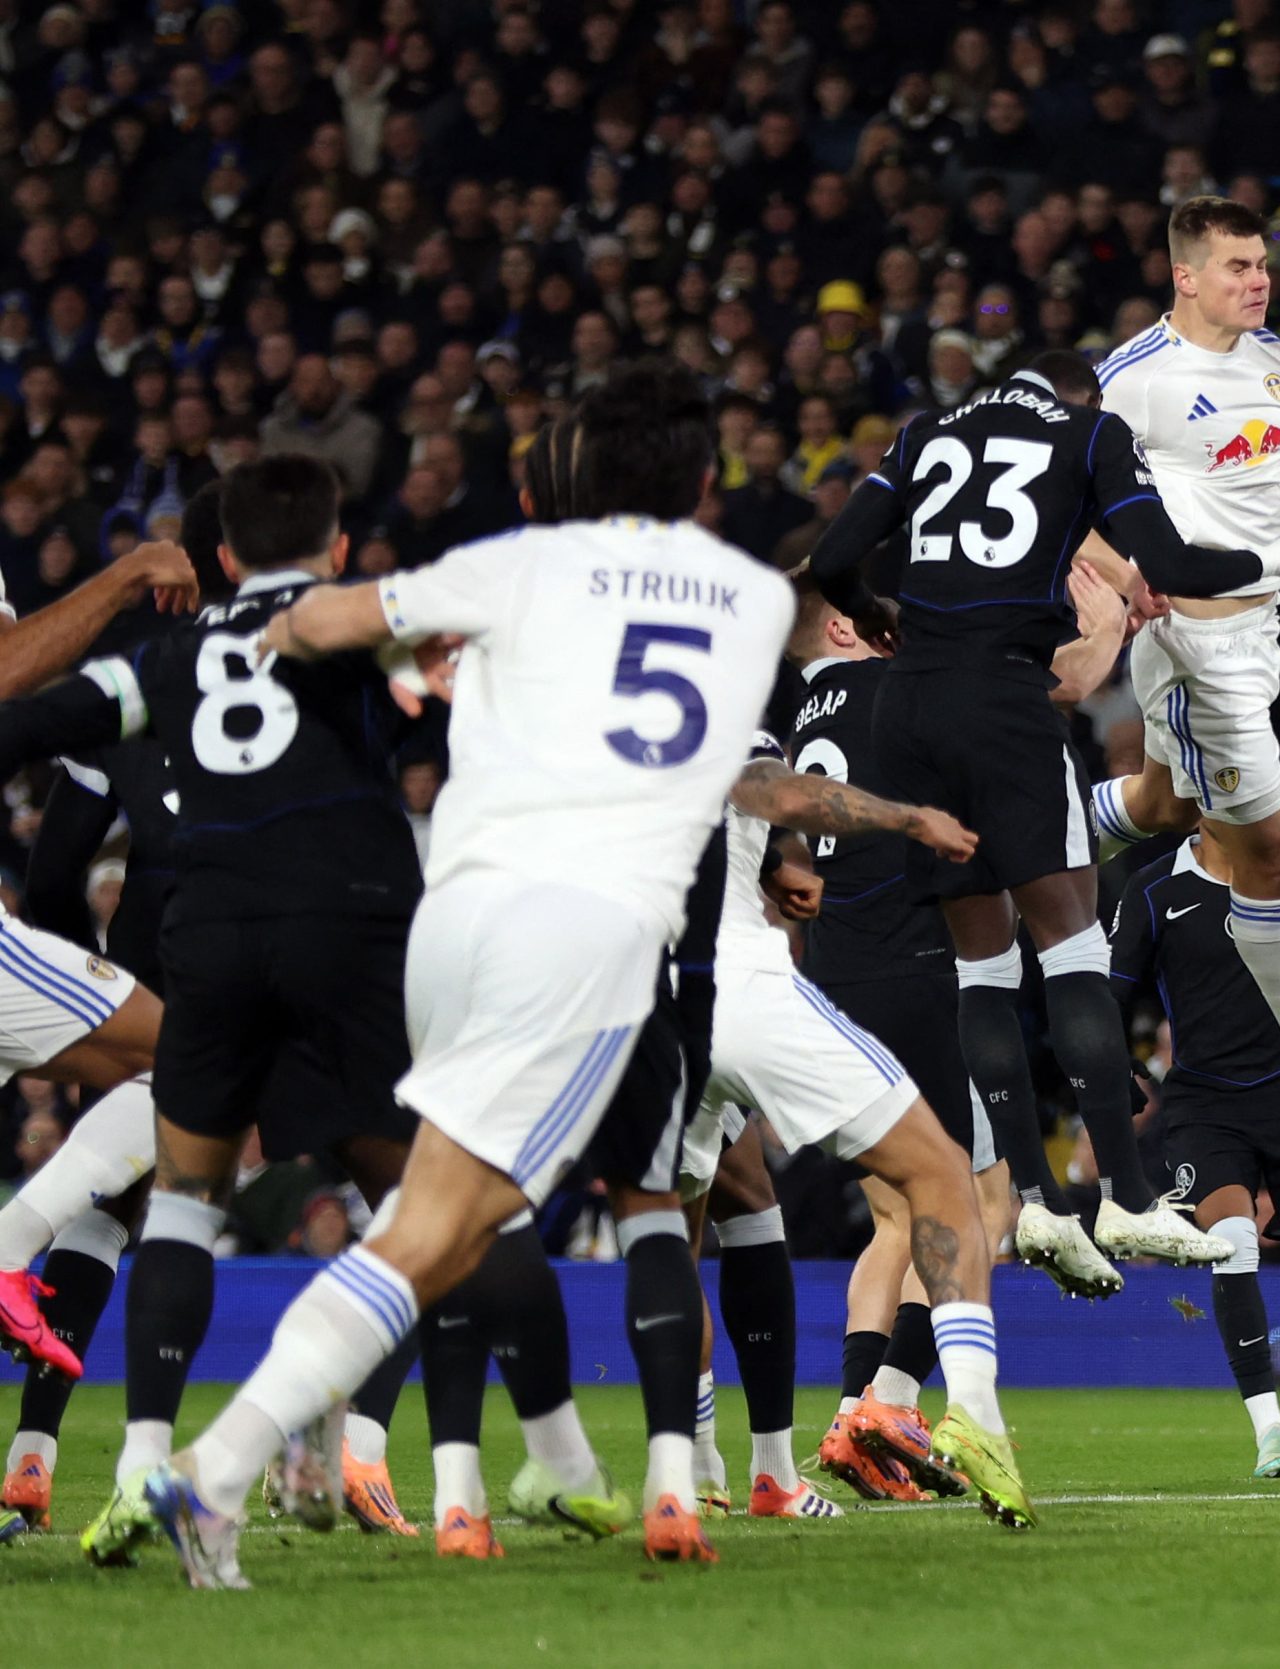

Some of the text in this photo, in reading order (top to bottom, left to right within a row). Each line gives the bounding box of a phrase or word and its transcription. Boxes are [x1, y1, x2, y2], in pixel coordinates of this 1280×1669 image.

[909, 436, 1054, 568] 23
[589, 568, 739, 618] STRUIJK
[191, 630, 299, 775] 8
[603, 621, 712, 770] 5
[794, 688, 848, 733] DELAP
[988, 1090, 1009, 1104] CFC
[53, 1327, 75, 1342] CFC
